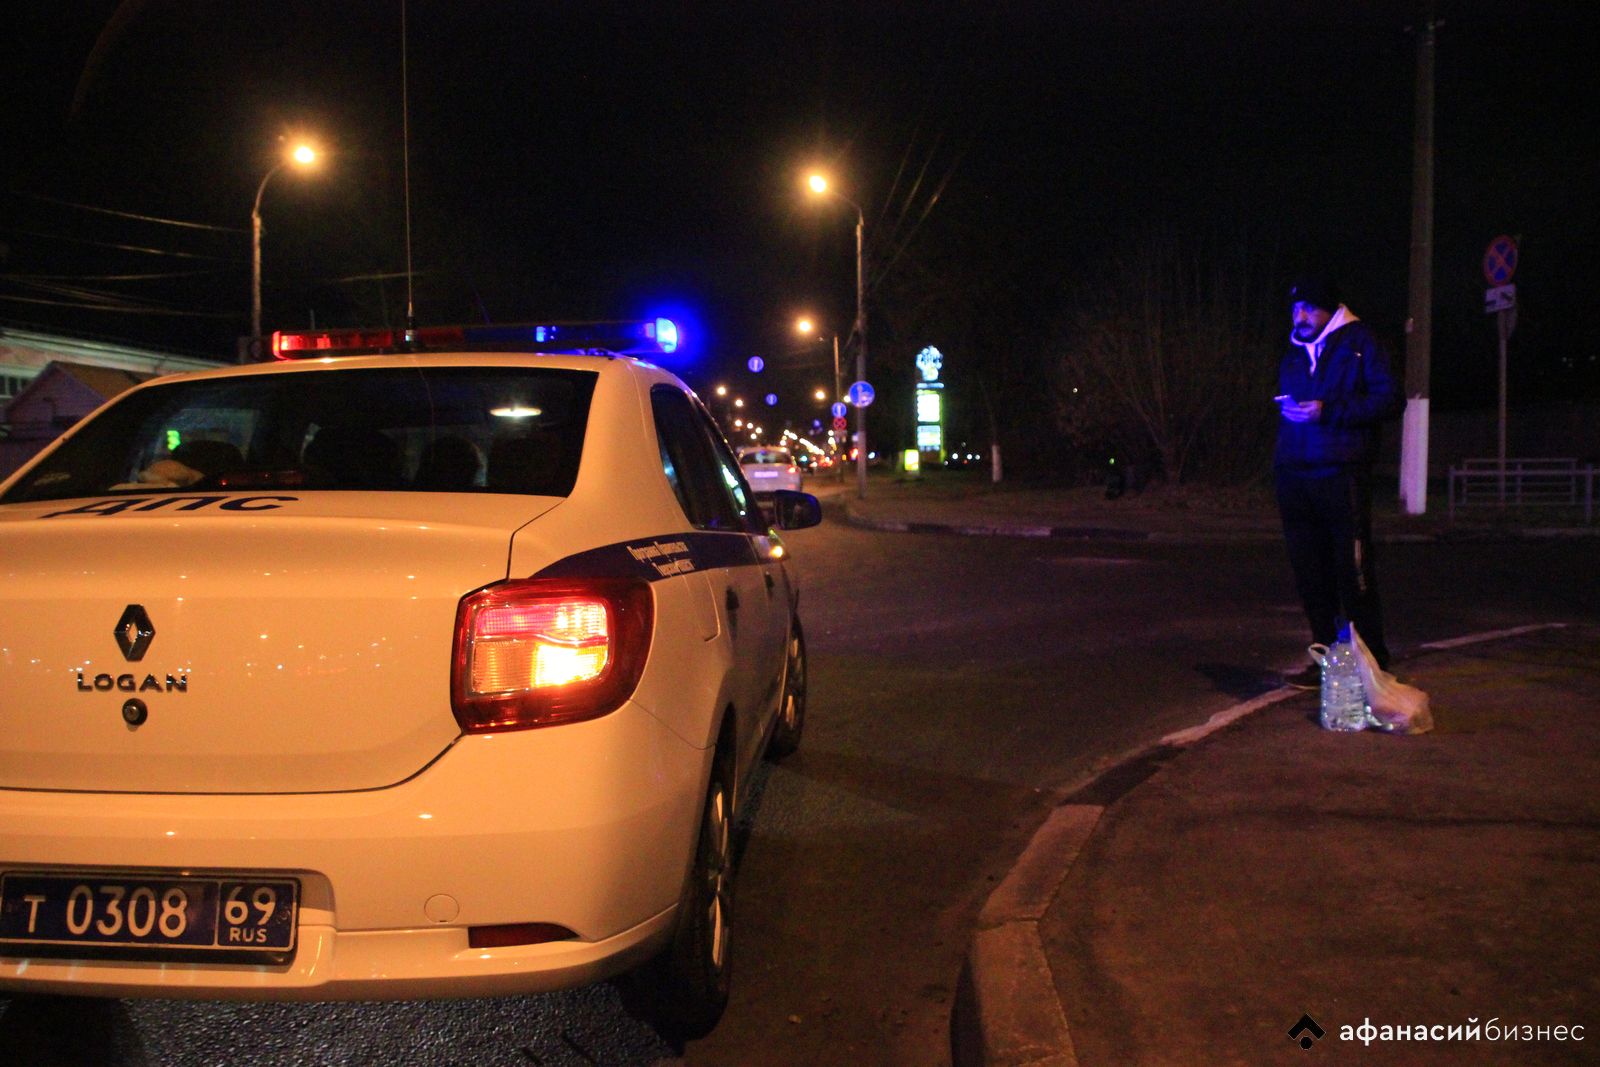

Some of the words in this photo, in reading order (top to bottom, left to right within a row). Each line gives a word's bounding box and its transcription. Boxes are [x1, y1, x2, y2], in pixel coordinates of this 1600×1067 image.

[38, 495, 299, 518] ДПС
[77, 672, 188, 692] LOGAN
[66, 885, 188, 938] 0308
[224, 886, 277, 926] 69
[229, 927, 268, 943] RUS
